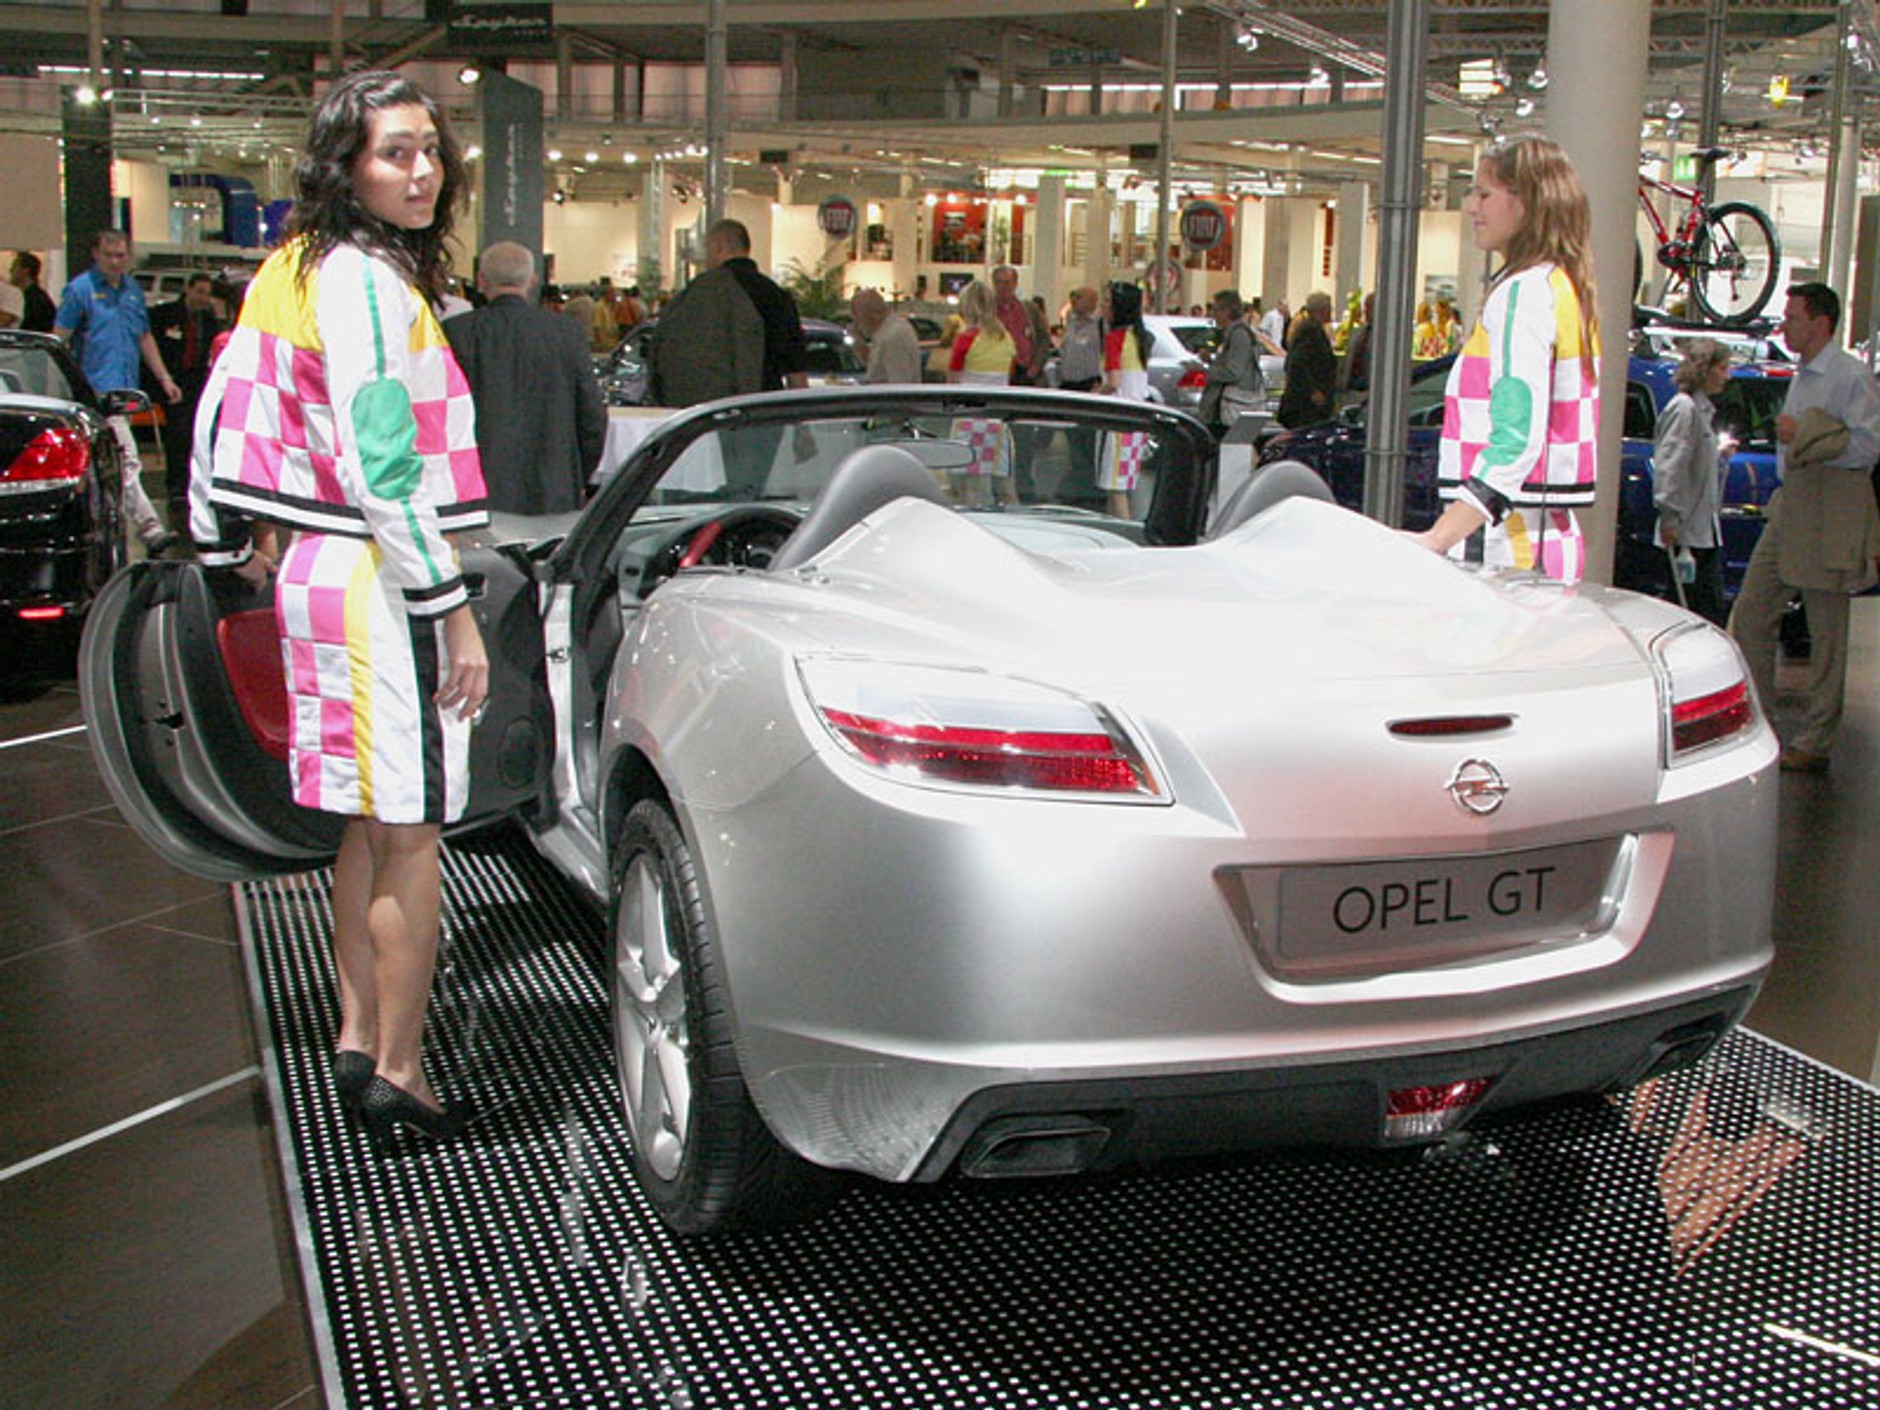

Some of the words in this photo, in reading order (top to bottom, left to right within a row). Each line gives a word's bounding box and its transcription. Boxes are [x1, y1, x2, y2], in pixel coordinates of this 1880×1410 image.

[1187, 215, 1221, 238] FIAT
[1333, 877, 1469, 934] OPEL
[1487, 865, 1556, 916] GT
